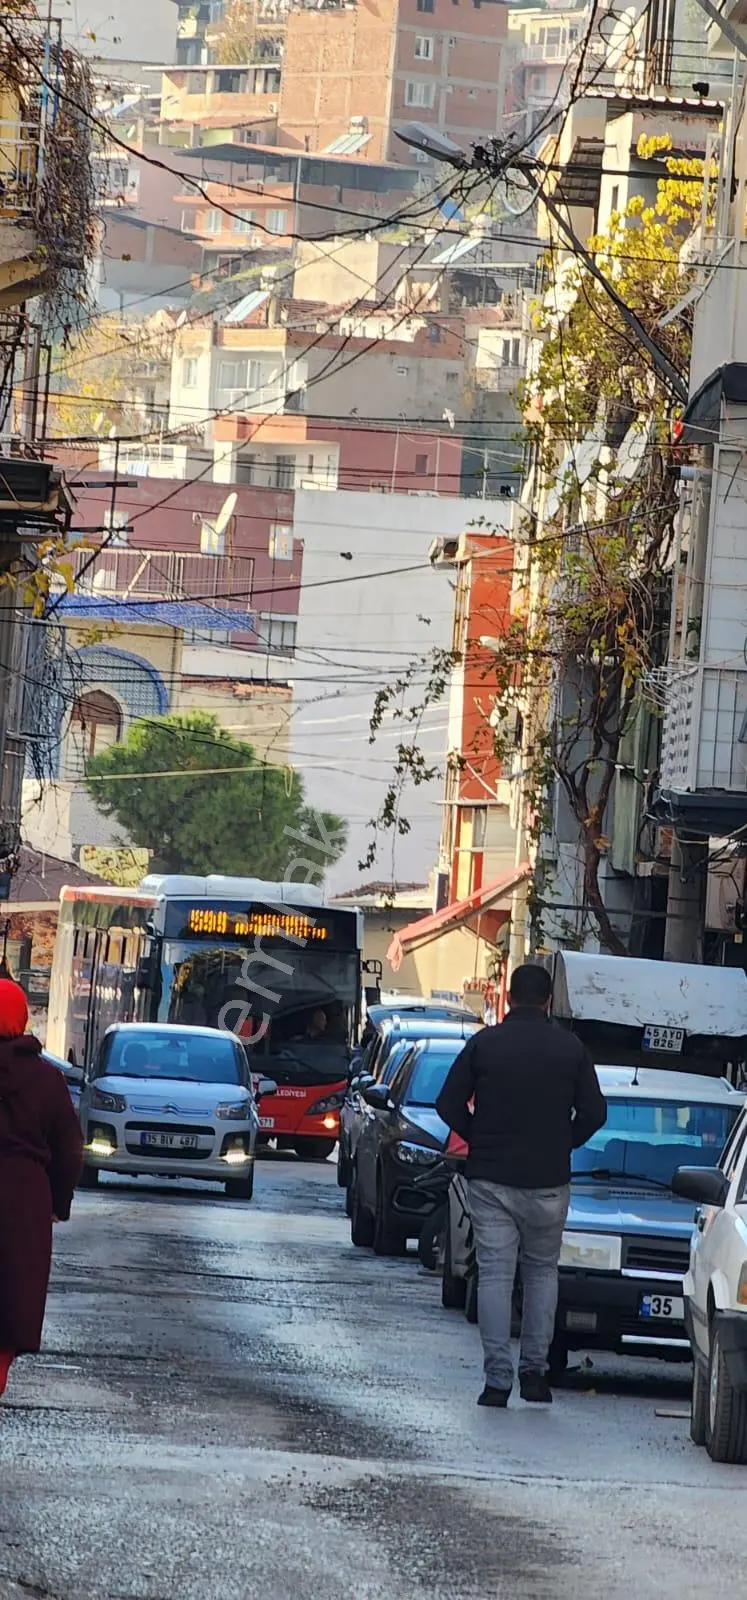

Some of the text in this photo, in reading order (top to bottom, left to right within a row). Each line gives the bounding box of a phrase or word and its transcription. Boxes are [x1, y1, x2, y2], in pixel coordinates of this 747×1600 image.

[646, 1028, 659, 1037] 45
[274, 1087, 307, 1098] LEDİYESİ
[651, 1297, 672, 1316] 35
